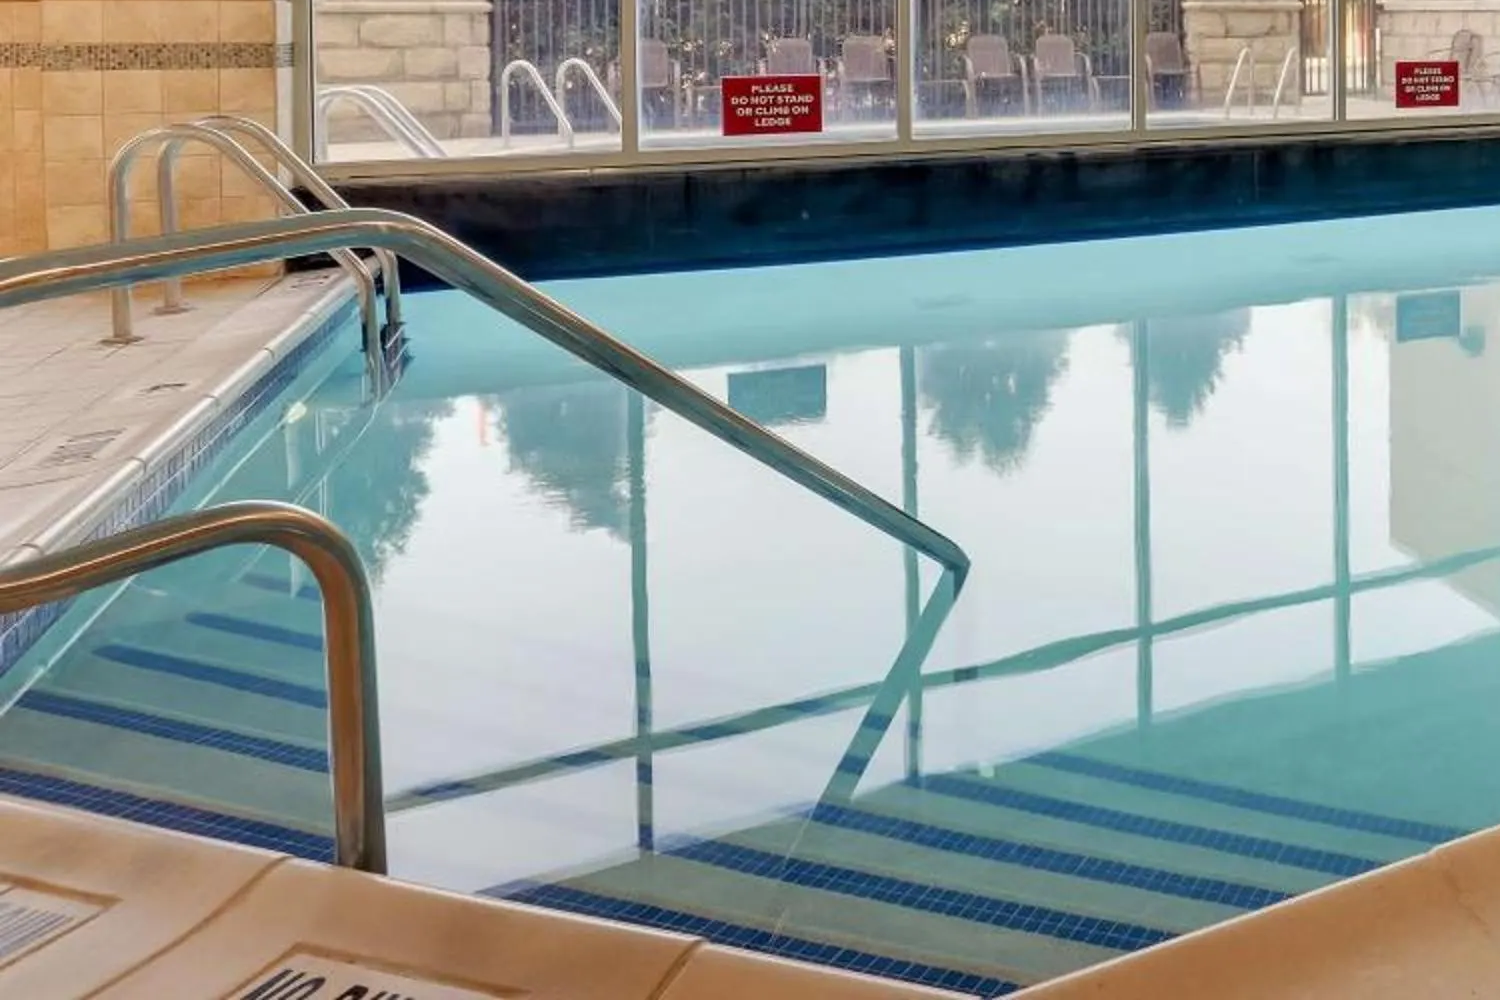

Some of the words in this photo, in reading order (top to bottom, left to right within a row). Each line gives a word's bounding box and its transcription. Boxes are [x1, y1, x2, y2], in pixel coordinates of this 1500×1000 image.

[751, 83, 794, 93] PLEASE
[731, 96, 749, 105] DO
[750, 95, 775, 105] NOT
[776, 94, 815, 104] STAND
[736, 107, 753, 117] OR
[755, 106, 790, 115] CLIMB
[791, 105, 809, 115] ON
[754, 117, 792, 127] LEDGE
